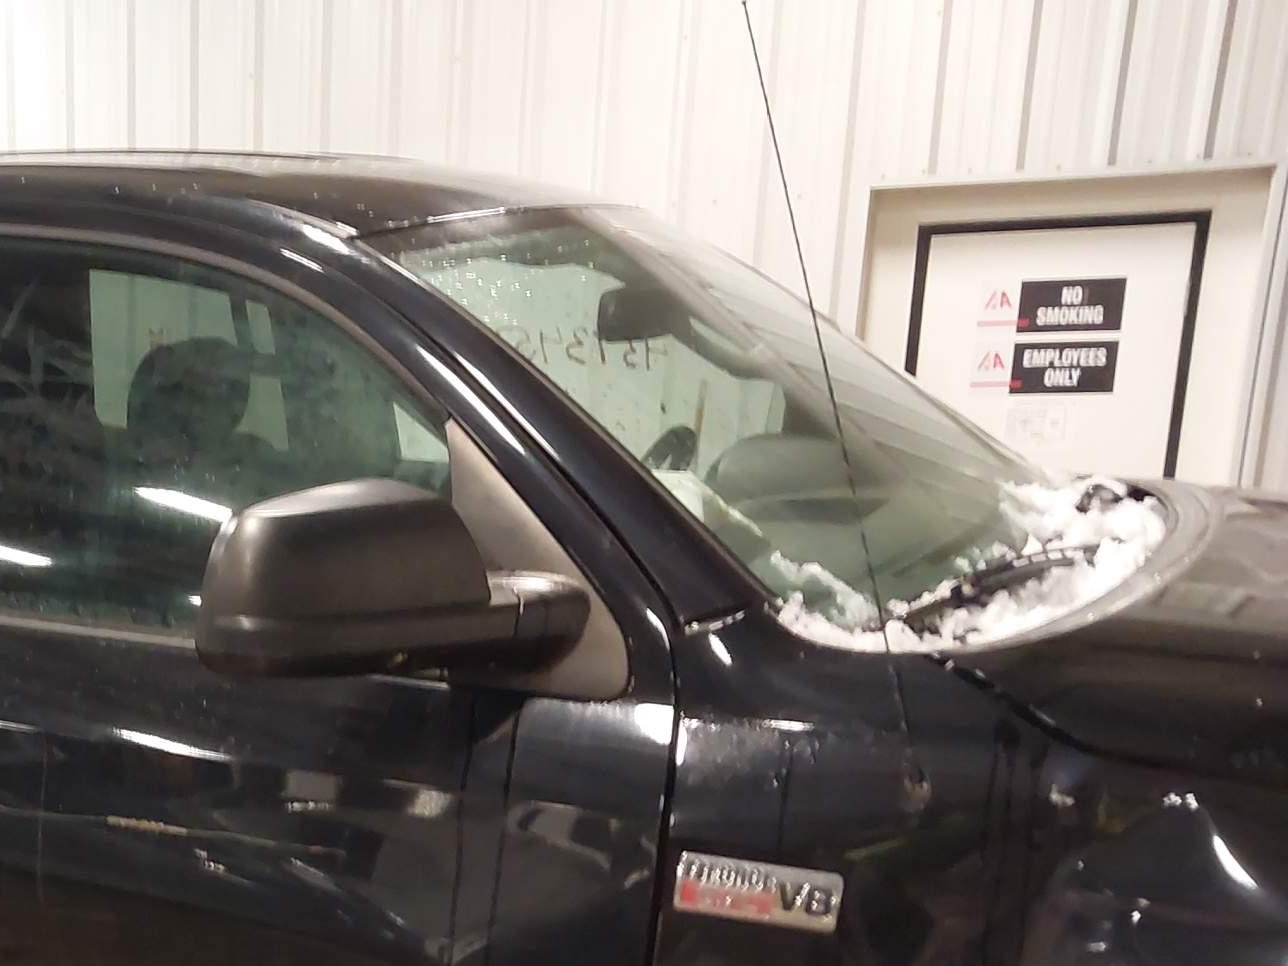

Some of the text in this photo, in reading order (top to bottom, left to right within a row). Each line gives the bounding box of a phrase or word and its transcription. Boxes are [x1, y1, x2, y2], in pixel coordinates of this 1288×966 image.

[1061, 286, 1083, 305] NO
[1036, 305, 1104, 326] SMOKING
[1022, 347, 1108, 368] EMPLOYEES
[1044, 367, 1082, 387] ONLY
[778, 881, 834, 916] V8
